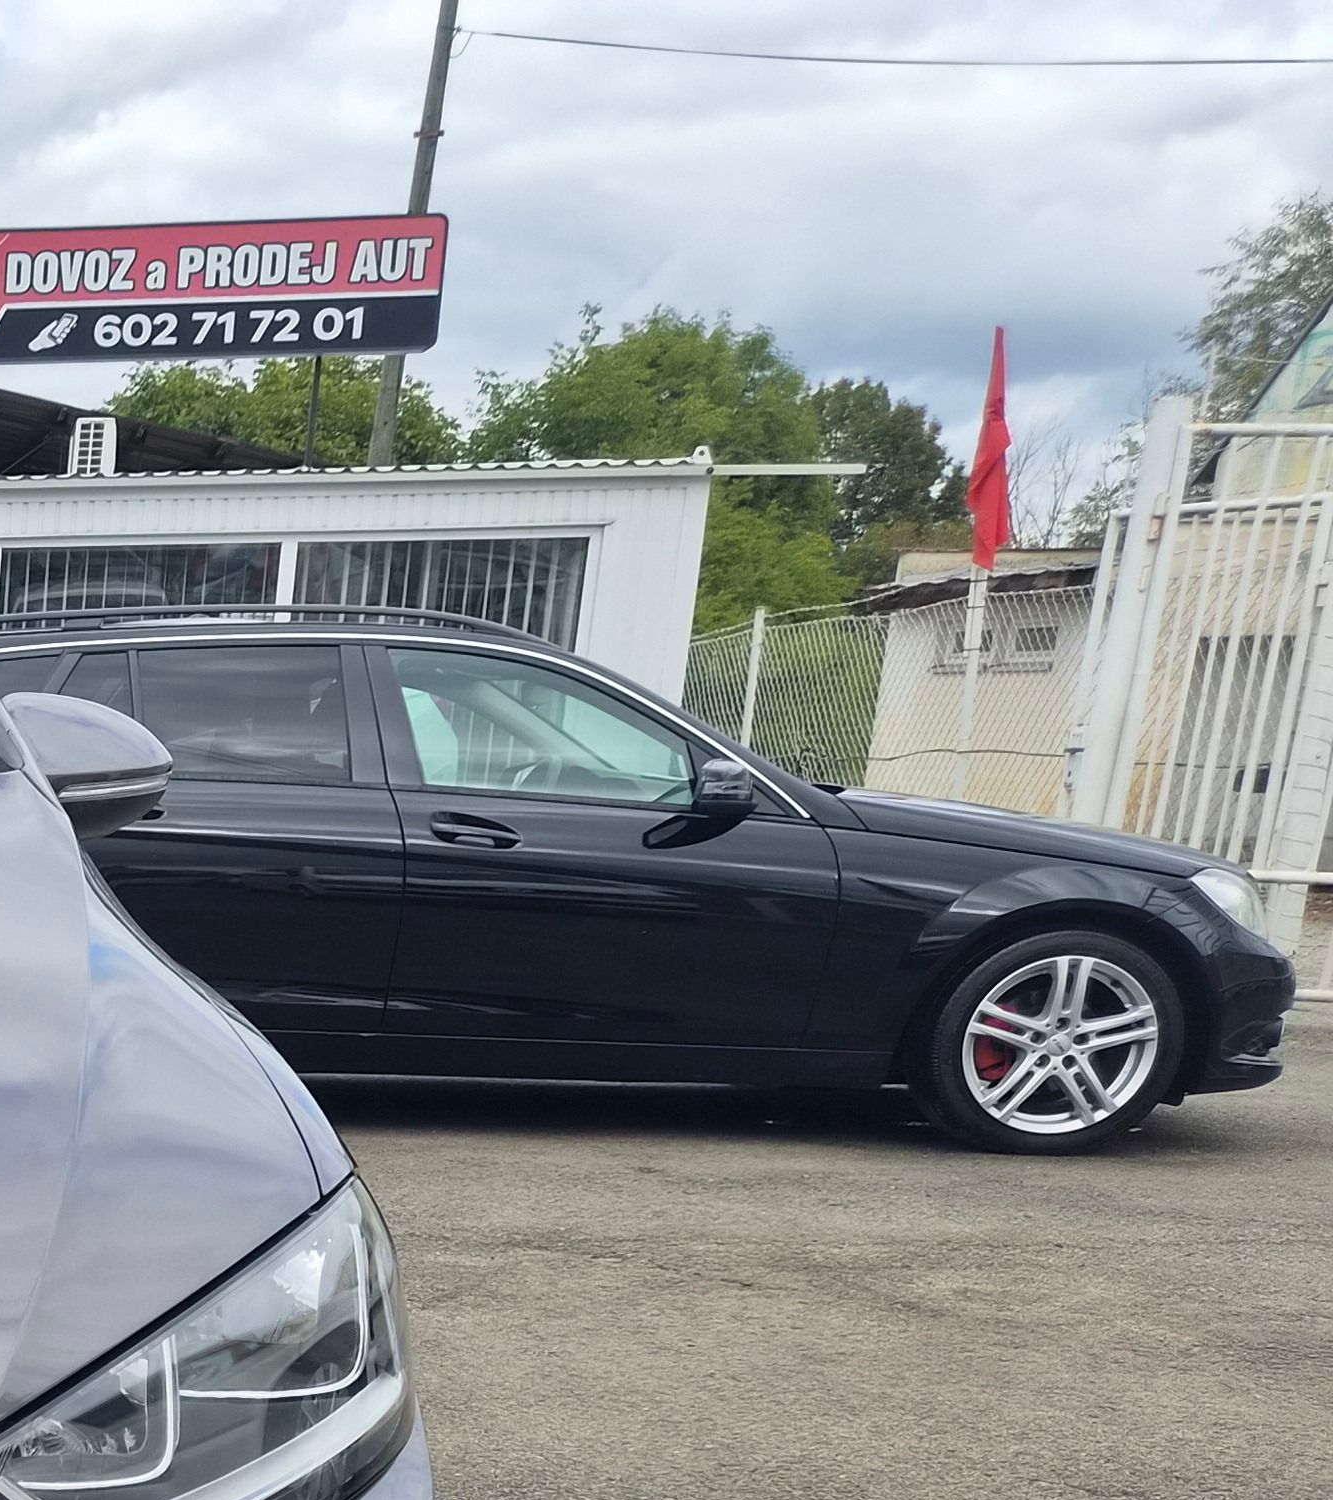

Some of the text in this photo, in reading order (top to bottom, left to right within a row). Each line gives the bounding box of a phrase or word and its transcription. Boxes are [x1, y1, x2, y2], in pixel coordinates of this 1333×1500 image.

[5, 237, 434, 294] DOVOZ a PRODEJ AUT
[94, 306, 365, 348] 602 71 72 01
